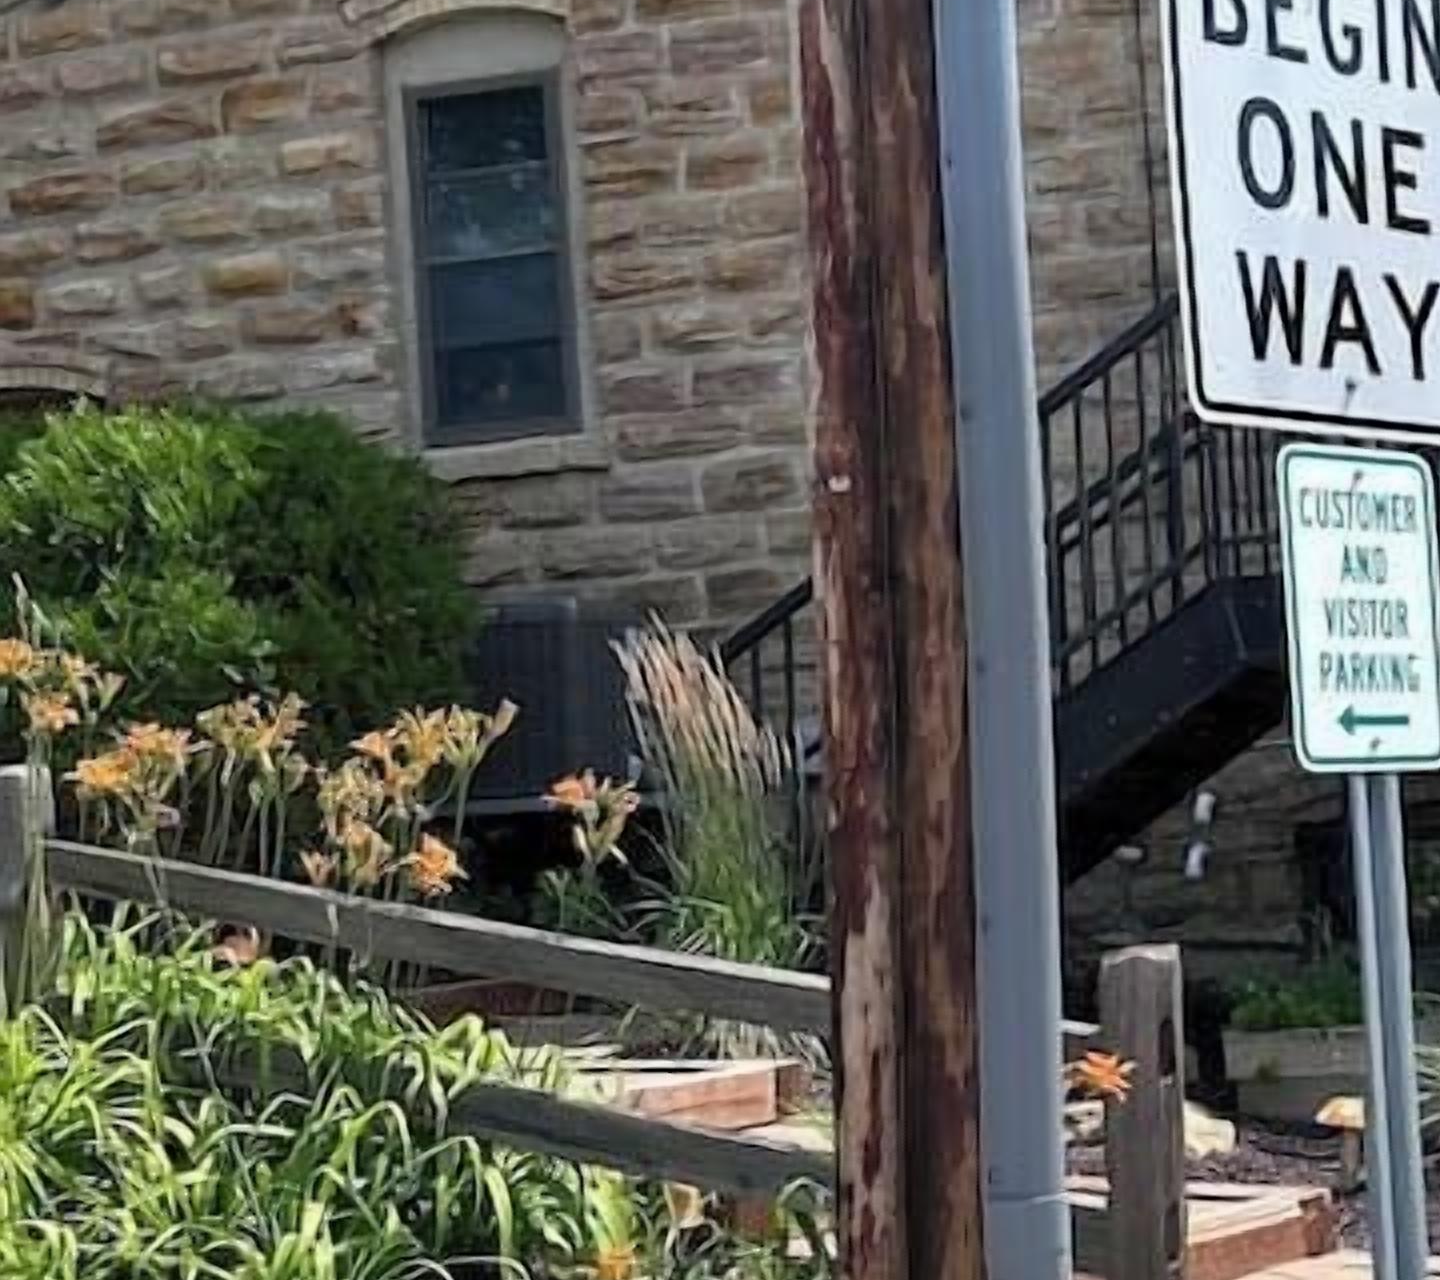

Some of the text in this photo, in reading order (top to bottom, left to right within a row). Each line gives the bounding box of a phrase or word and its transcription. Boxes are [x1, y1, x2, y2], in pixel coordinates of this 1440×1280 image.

[1237, 96, 1431, 236] ONE
[1234, 249, 1440, 382] WAY
[1299, 487, 1417, 533] CUSTOMER
[1341, 545, 1389, 585] AND
[1324, 598, 1409, 640] VISITOR
[1319, 652, 1421, 693] PARKING
